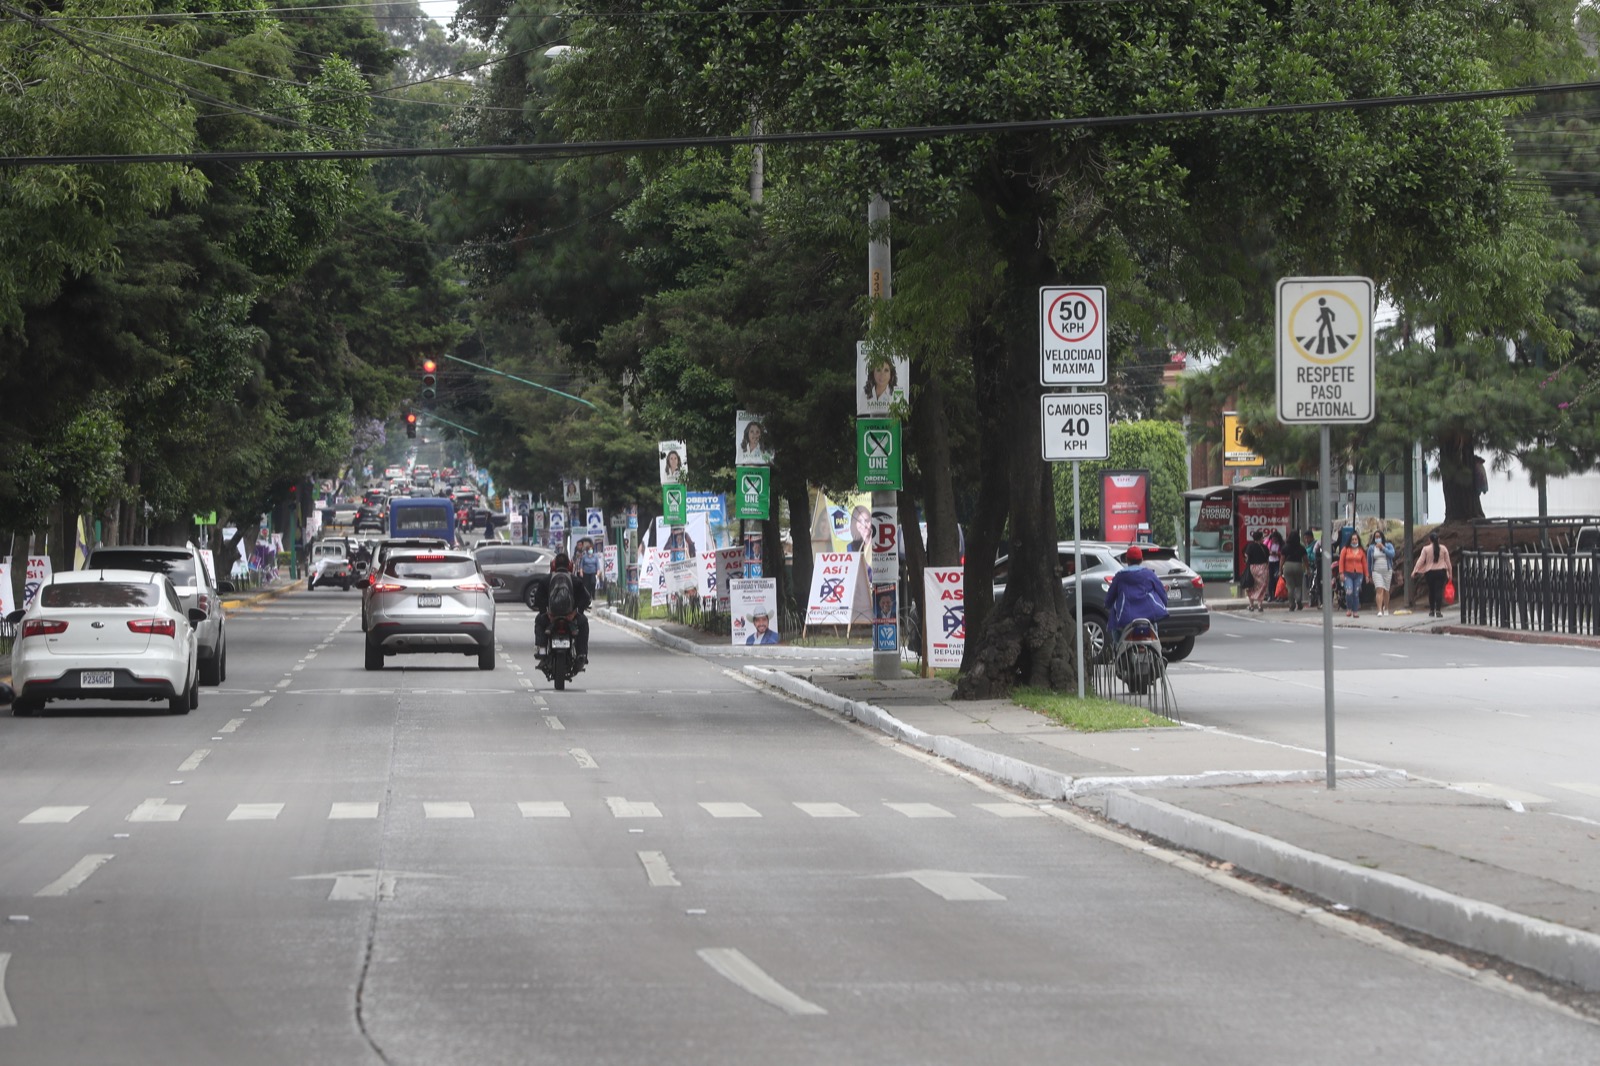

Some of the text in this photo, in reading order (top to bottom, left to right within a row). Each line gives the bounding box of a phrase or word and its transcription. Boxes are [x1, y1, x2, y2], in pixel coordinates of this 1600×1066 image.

[1060, 301, 1086, 320] 50
[1062, 322, 1085, 333] KPH
[1045, 349, 1102, 361] VELOCIDAD
[1052, 363, 1095, 374] MAXIMA
[1297, 366, 1355, 383] RESPETE
[1311, 384, 1342, 400] PASO
[1047, 403, 1103, 416] CAMIONES
[1296, 402, 1357, 417] PEATONAL
[1061, 418, 1089, 436] 40
[1064, 440, 1087, 450] KPH
[869, 457, 888, 469] UNE
[744, 494, 759, 503] UNE
[685, 503, 720, 511] ONZÁLEZ
[1244, 515, 1267, 526] 300
[822, 553, 853, 562] VOTA
